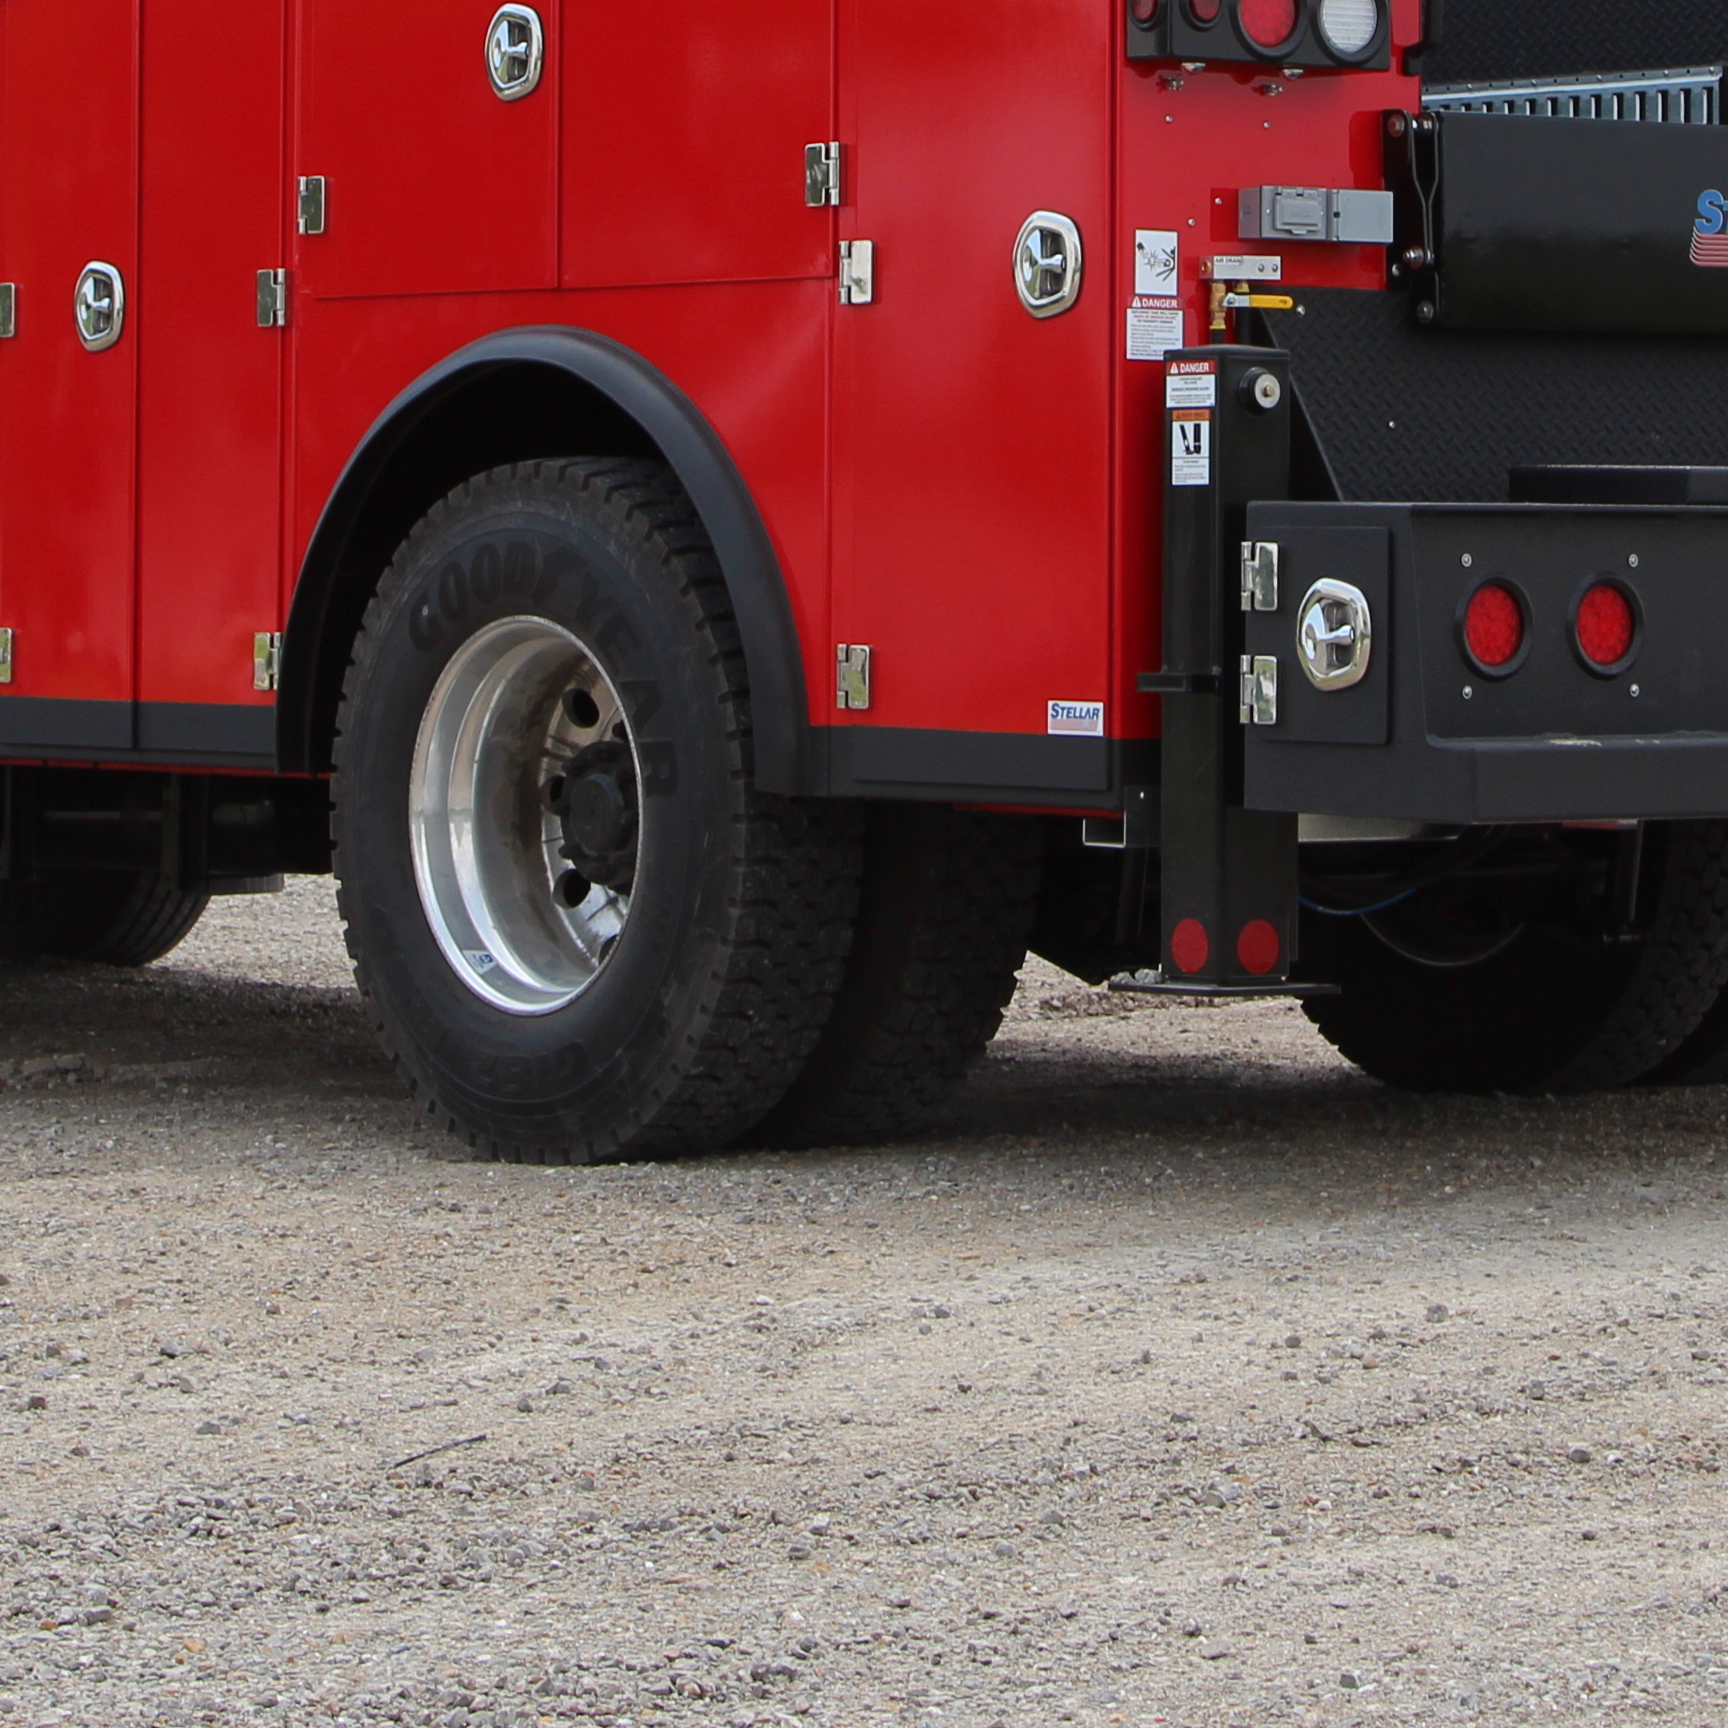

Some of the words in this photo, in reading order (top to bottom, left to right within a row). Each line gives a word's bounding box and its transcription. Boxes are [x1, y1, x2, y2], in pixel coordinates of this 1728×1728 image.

[1142, 298, 1178, 308] DANGER
[1179, 362, 1209, 373] DANGER
[1050, 702, 1100, 720] STELLAR
